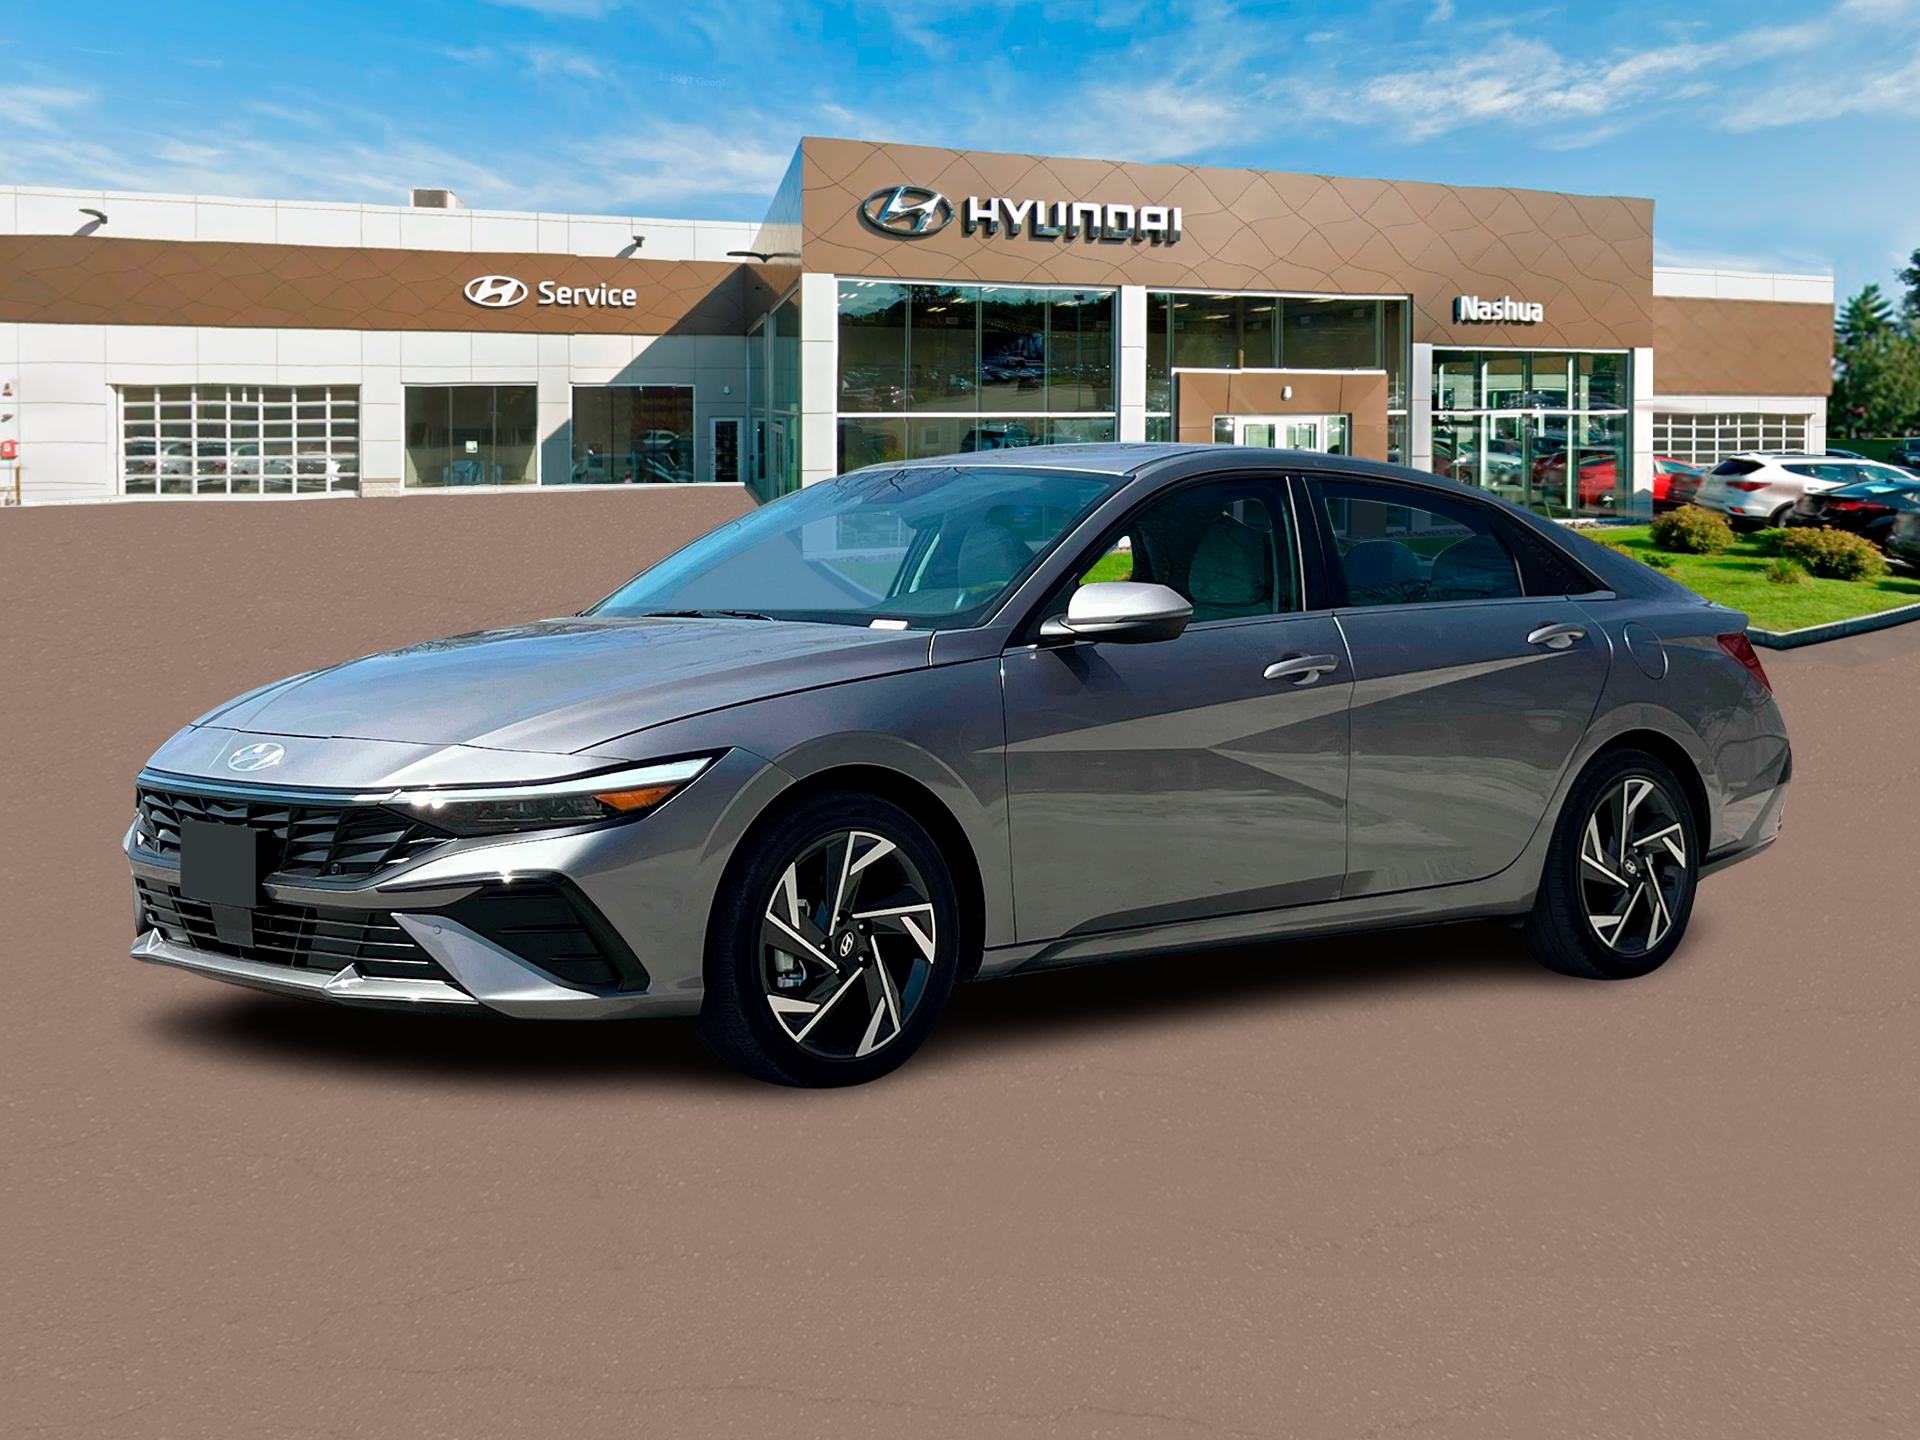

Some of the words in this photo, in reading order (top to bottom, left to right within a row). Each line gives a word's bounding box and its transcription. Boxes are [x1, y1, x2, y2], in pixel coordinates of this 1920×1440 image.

[966, 196, 1183, 243] HYUNDAI
[538, 281, 637, 306] Service
[1459, 295, 1544, 323] Nashua
